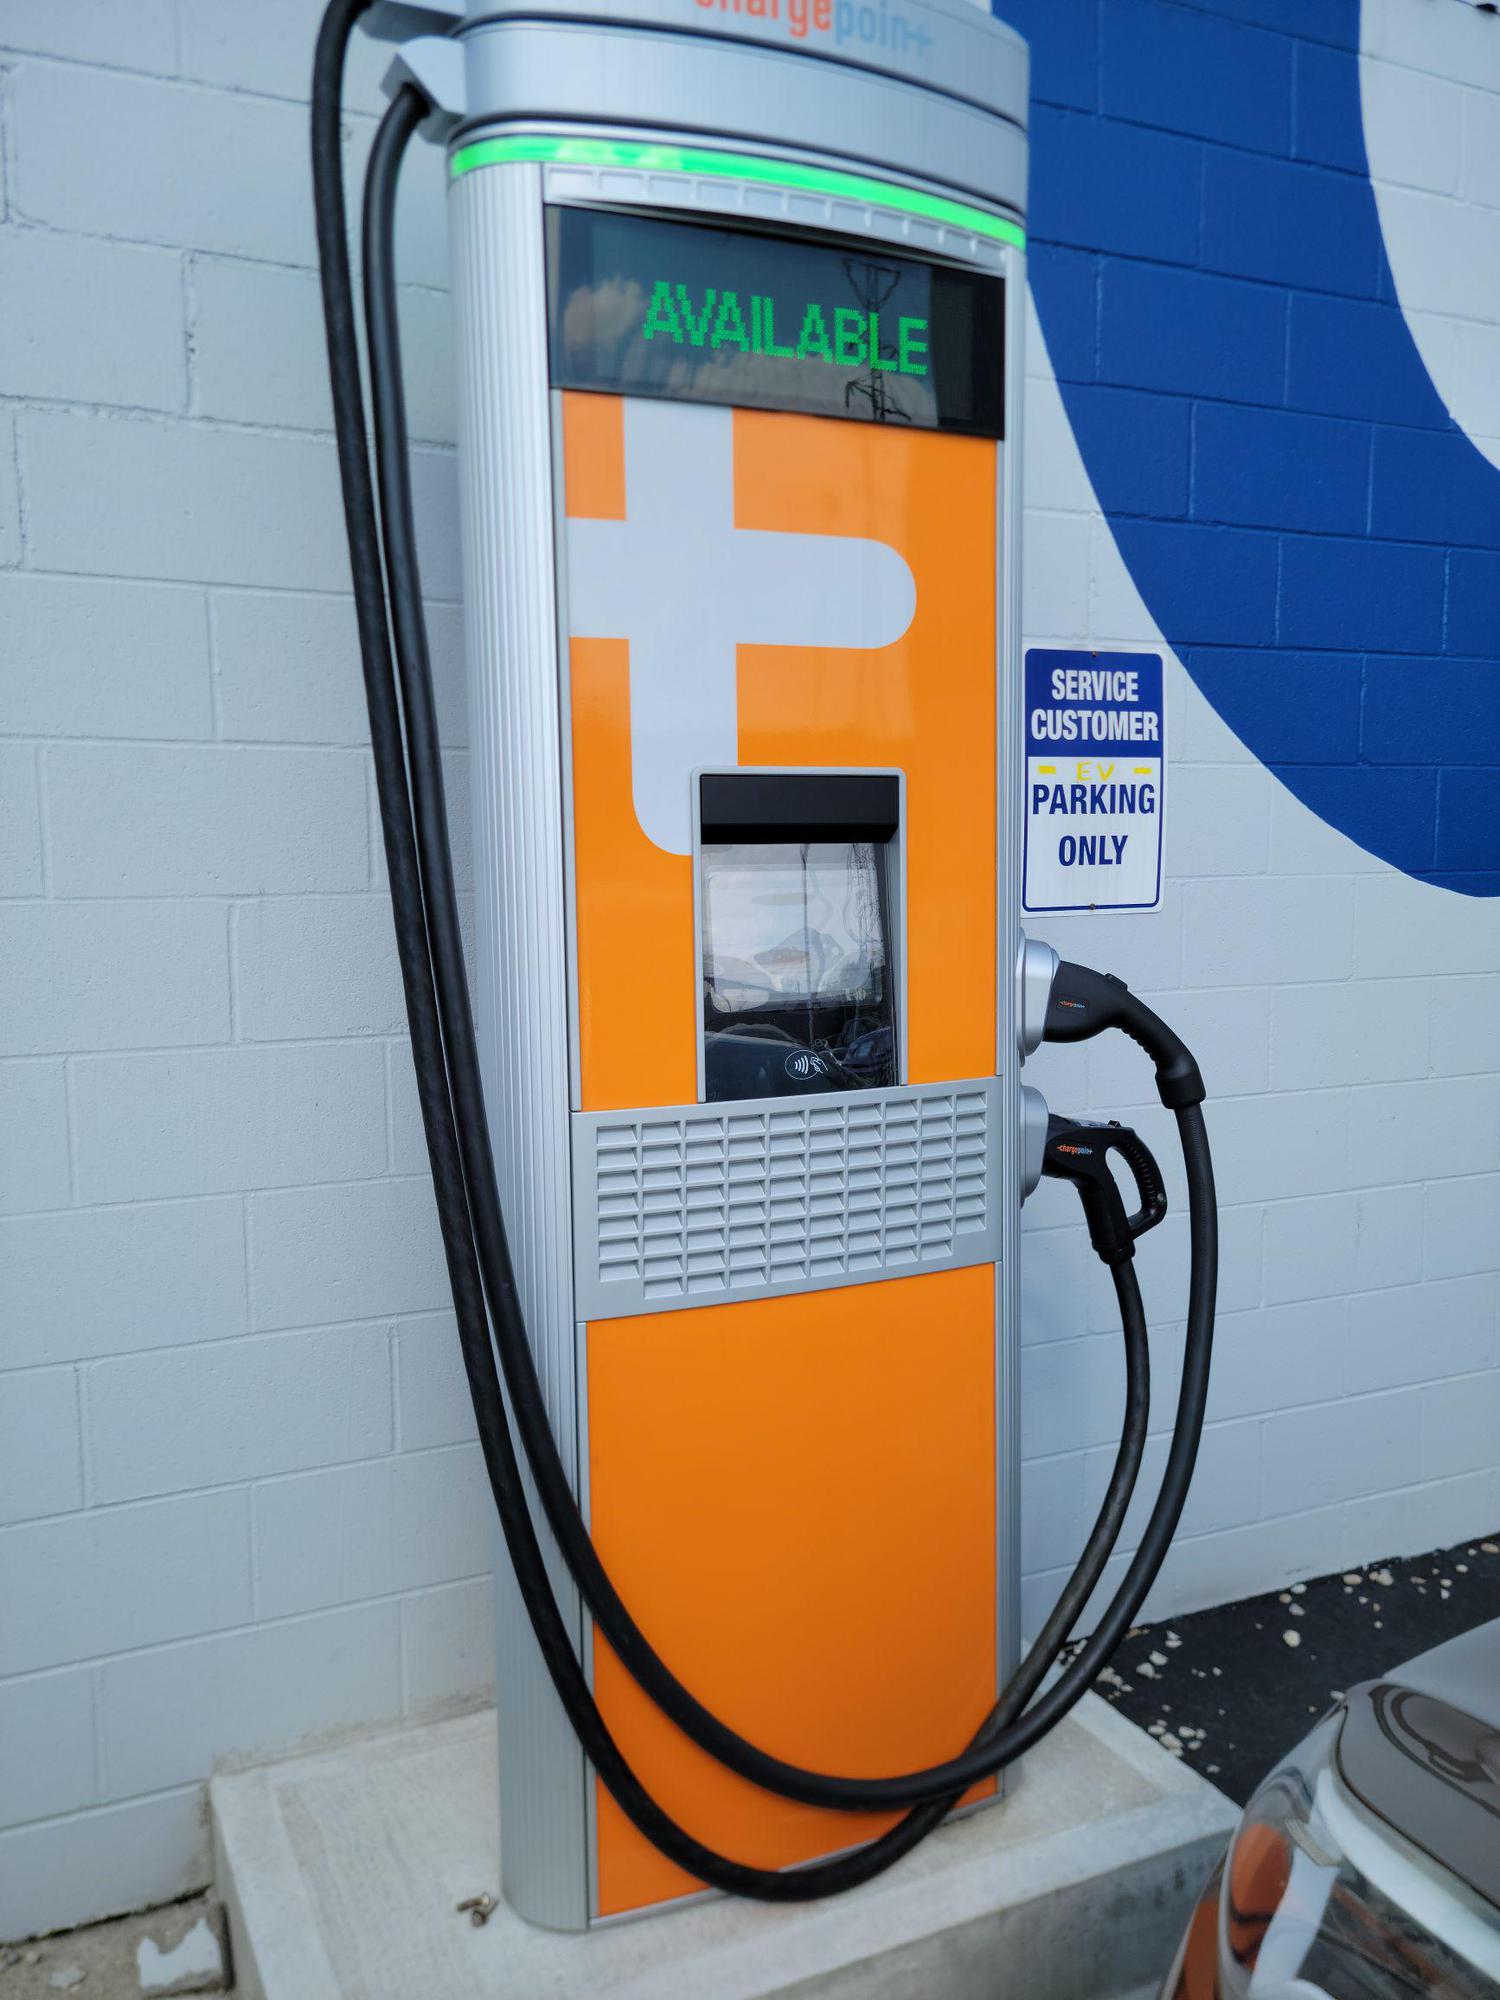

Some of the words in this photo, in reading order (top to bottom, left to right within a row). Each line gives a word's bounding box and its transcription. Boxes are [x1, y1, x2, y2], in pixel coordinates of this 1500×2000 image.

[695, 0, 934, 57] rgepoint
[643, 280, 928, 375] AVAILABLE
[1051, 668, 1139, 702] SERVICE
[1031, 709, 1159, 741] CUSTOMER
[1076, 762, 1115, 782] EV
[1032, 784, 1155, 815] PARKING
[1058, 835, 1129, 866] ONLY
